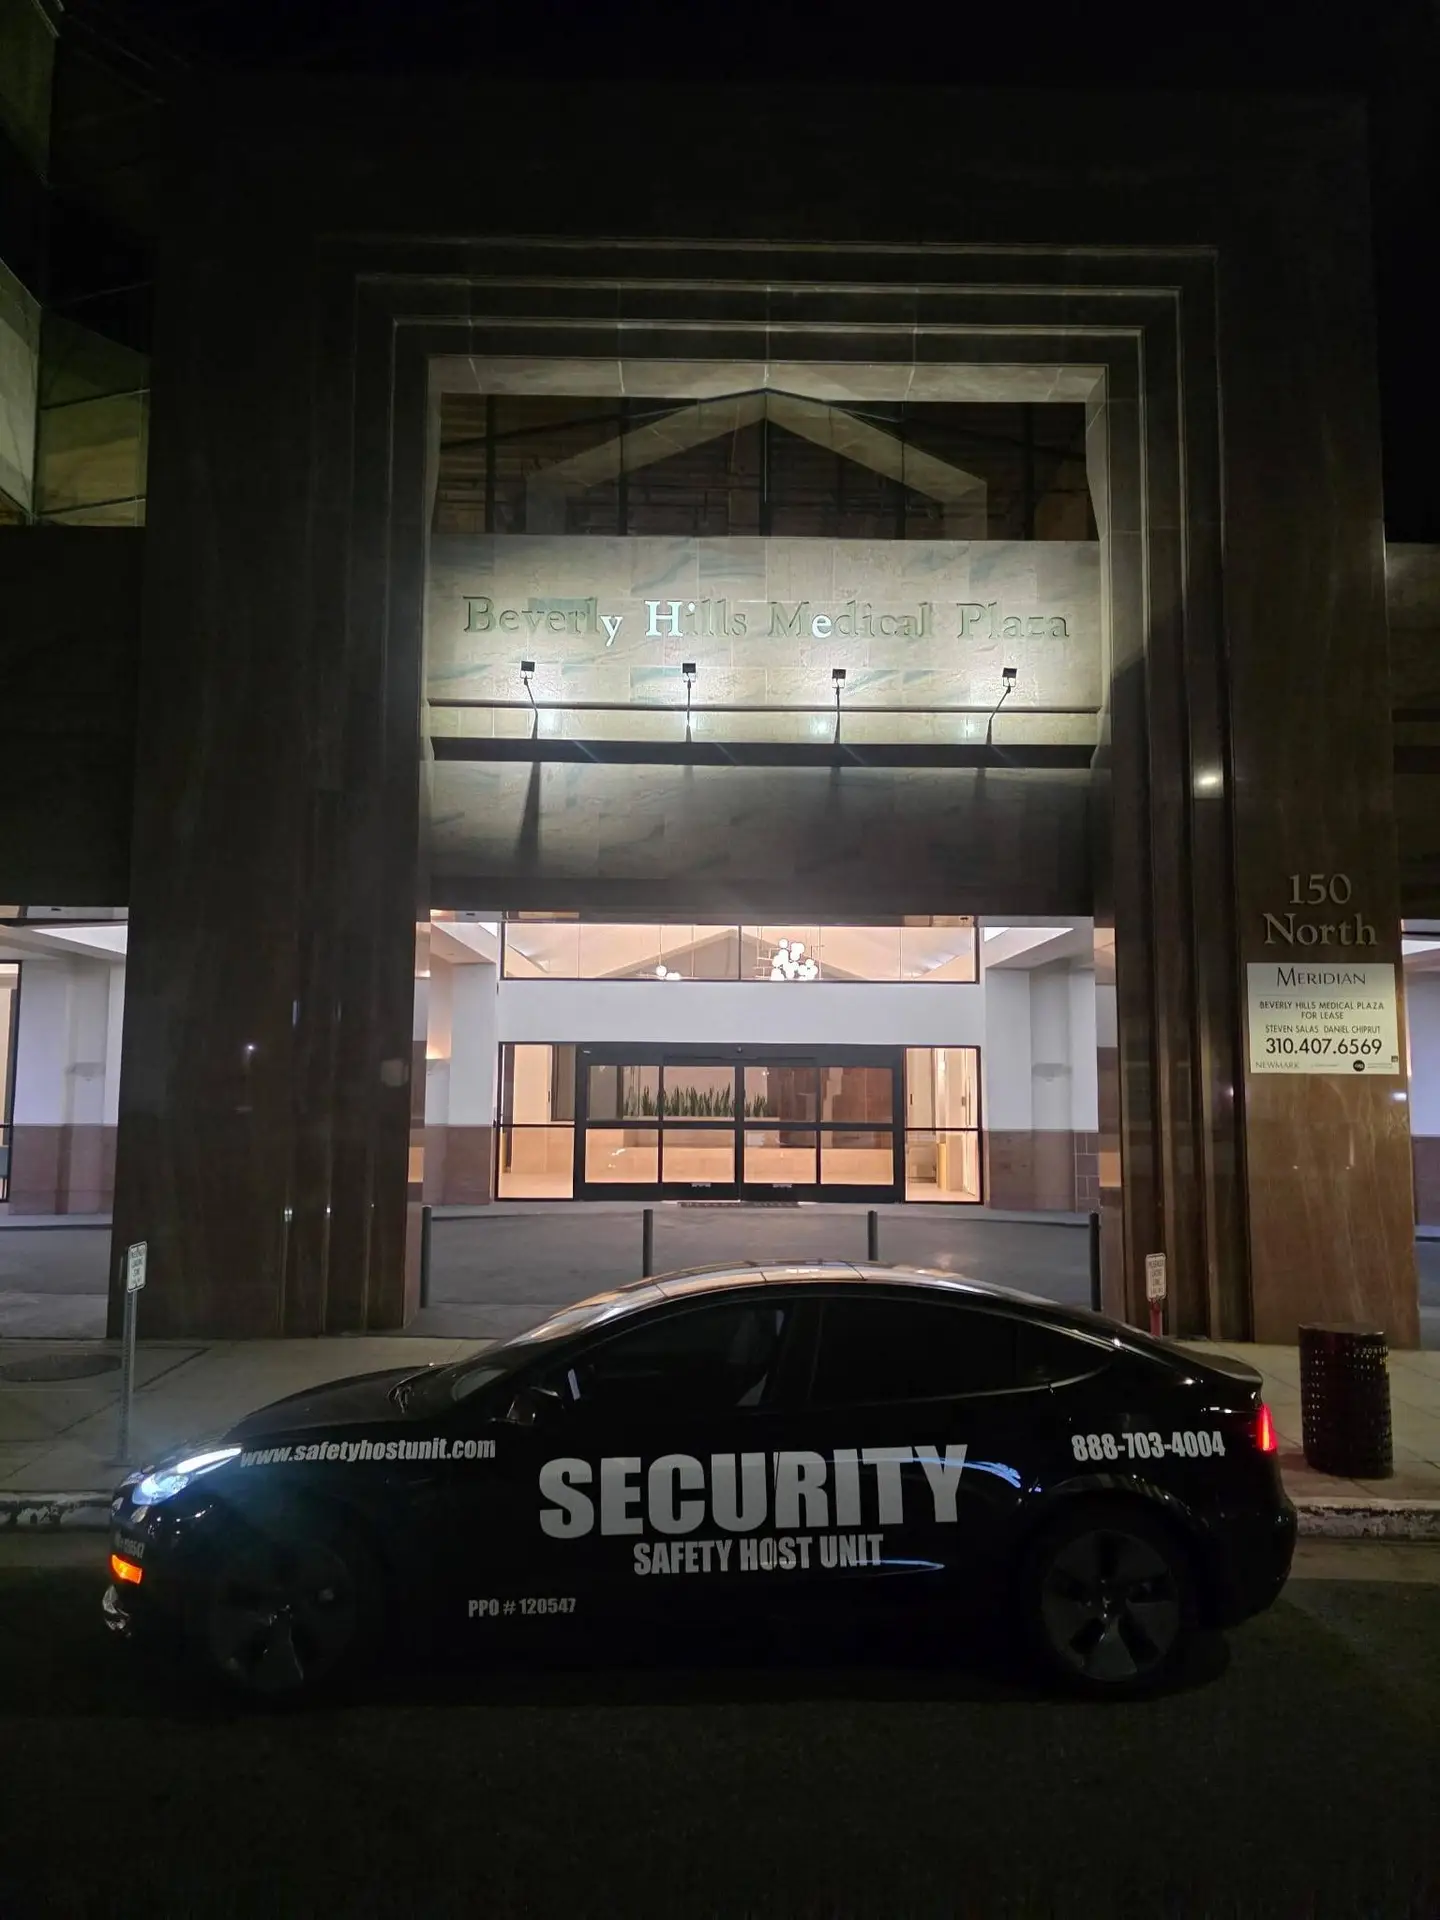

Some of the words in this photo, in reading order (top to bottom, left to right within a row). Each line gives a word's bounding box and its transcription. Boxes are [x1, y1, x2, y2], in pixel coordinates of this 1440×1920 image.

[462, 595, 623, 647] Beverly
[643, 599, 749, 638] Hills
[766, 599, 935, 640] Medical
[955, 601, 1070, 640] Plaza
[1289, 873, 1352, 905] 150
[1263, 913, 1378, 946] North
[1277, 966, 1366, 988] MERIDIAN
[1259, 1001, 1293, 1010] BEVERLY
[1295, 1001, 1317, 1010] HILLS
[1318, 1001, 1354, 1010] MEDICAL
[1356, 1001, 1385, 1010] PLAZA
[1301, 1011, 1318, 1020] FOR
[1320, 1011, 1344, 1020] LEASE
[1265, 1024, 1293, 1033] STEVEN
[1295, 1024, 1319, 1033] SALAS
[1323, 1024, 1349, 1033] DANIEL
[1351, 1024, 1381, 1034] CHIPRUT
[1265, 1037, 1383, 1055] 310.407.6569
[1255, 1060, 1300, 1069] NEWMARK
[240, 1437, 496, 1468] www.safetyhostunit.com
[1071, 1431, 1226, 1462] 888-703-4004
[538, 1444, 968, 1539] SECURITY
[633, 1539, 732, 1576] SAFETY
[739, 1537, 812, 1571] HOST
[820, 1534, 884, 1569] UNIT
[468, 1598, 499, 1618] PPO
[503, 1600, 516, 1616] #
[519, 1597, 577, 1615] 120547
